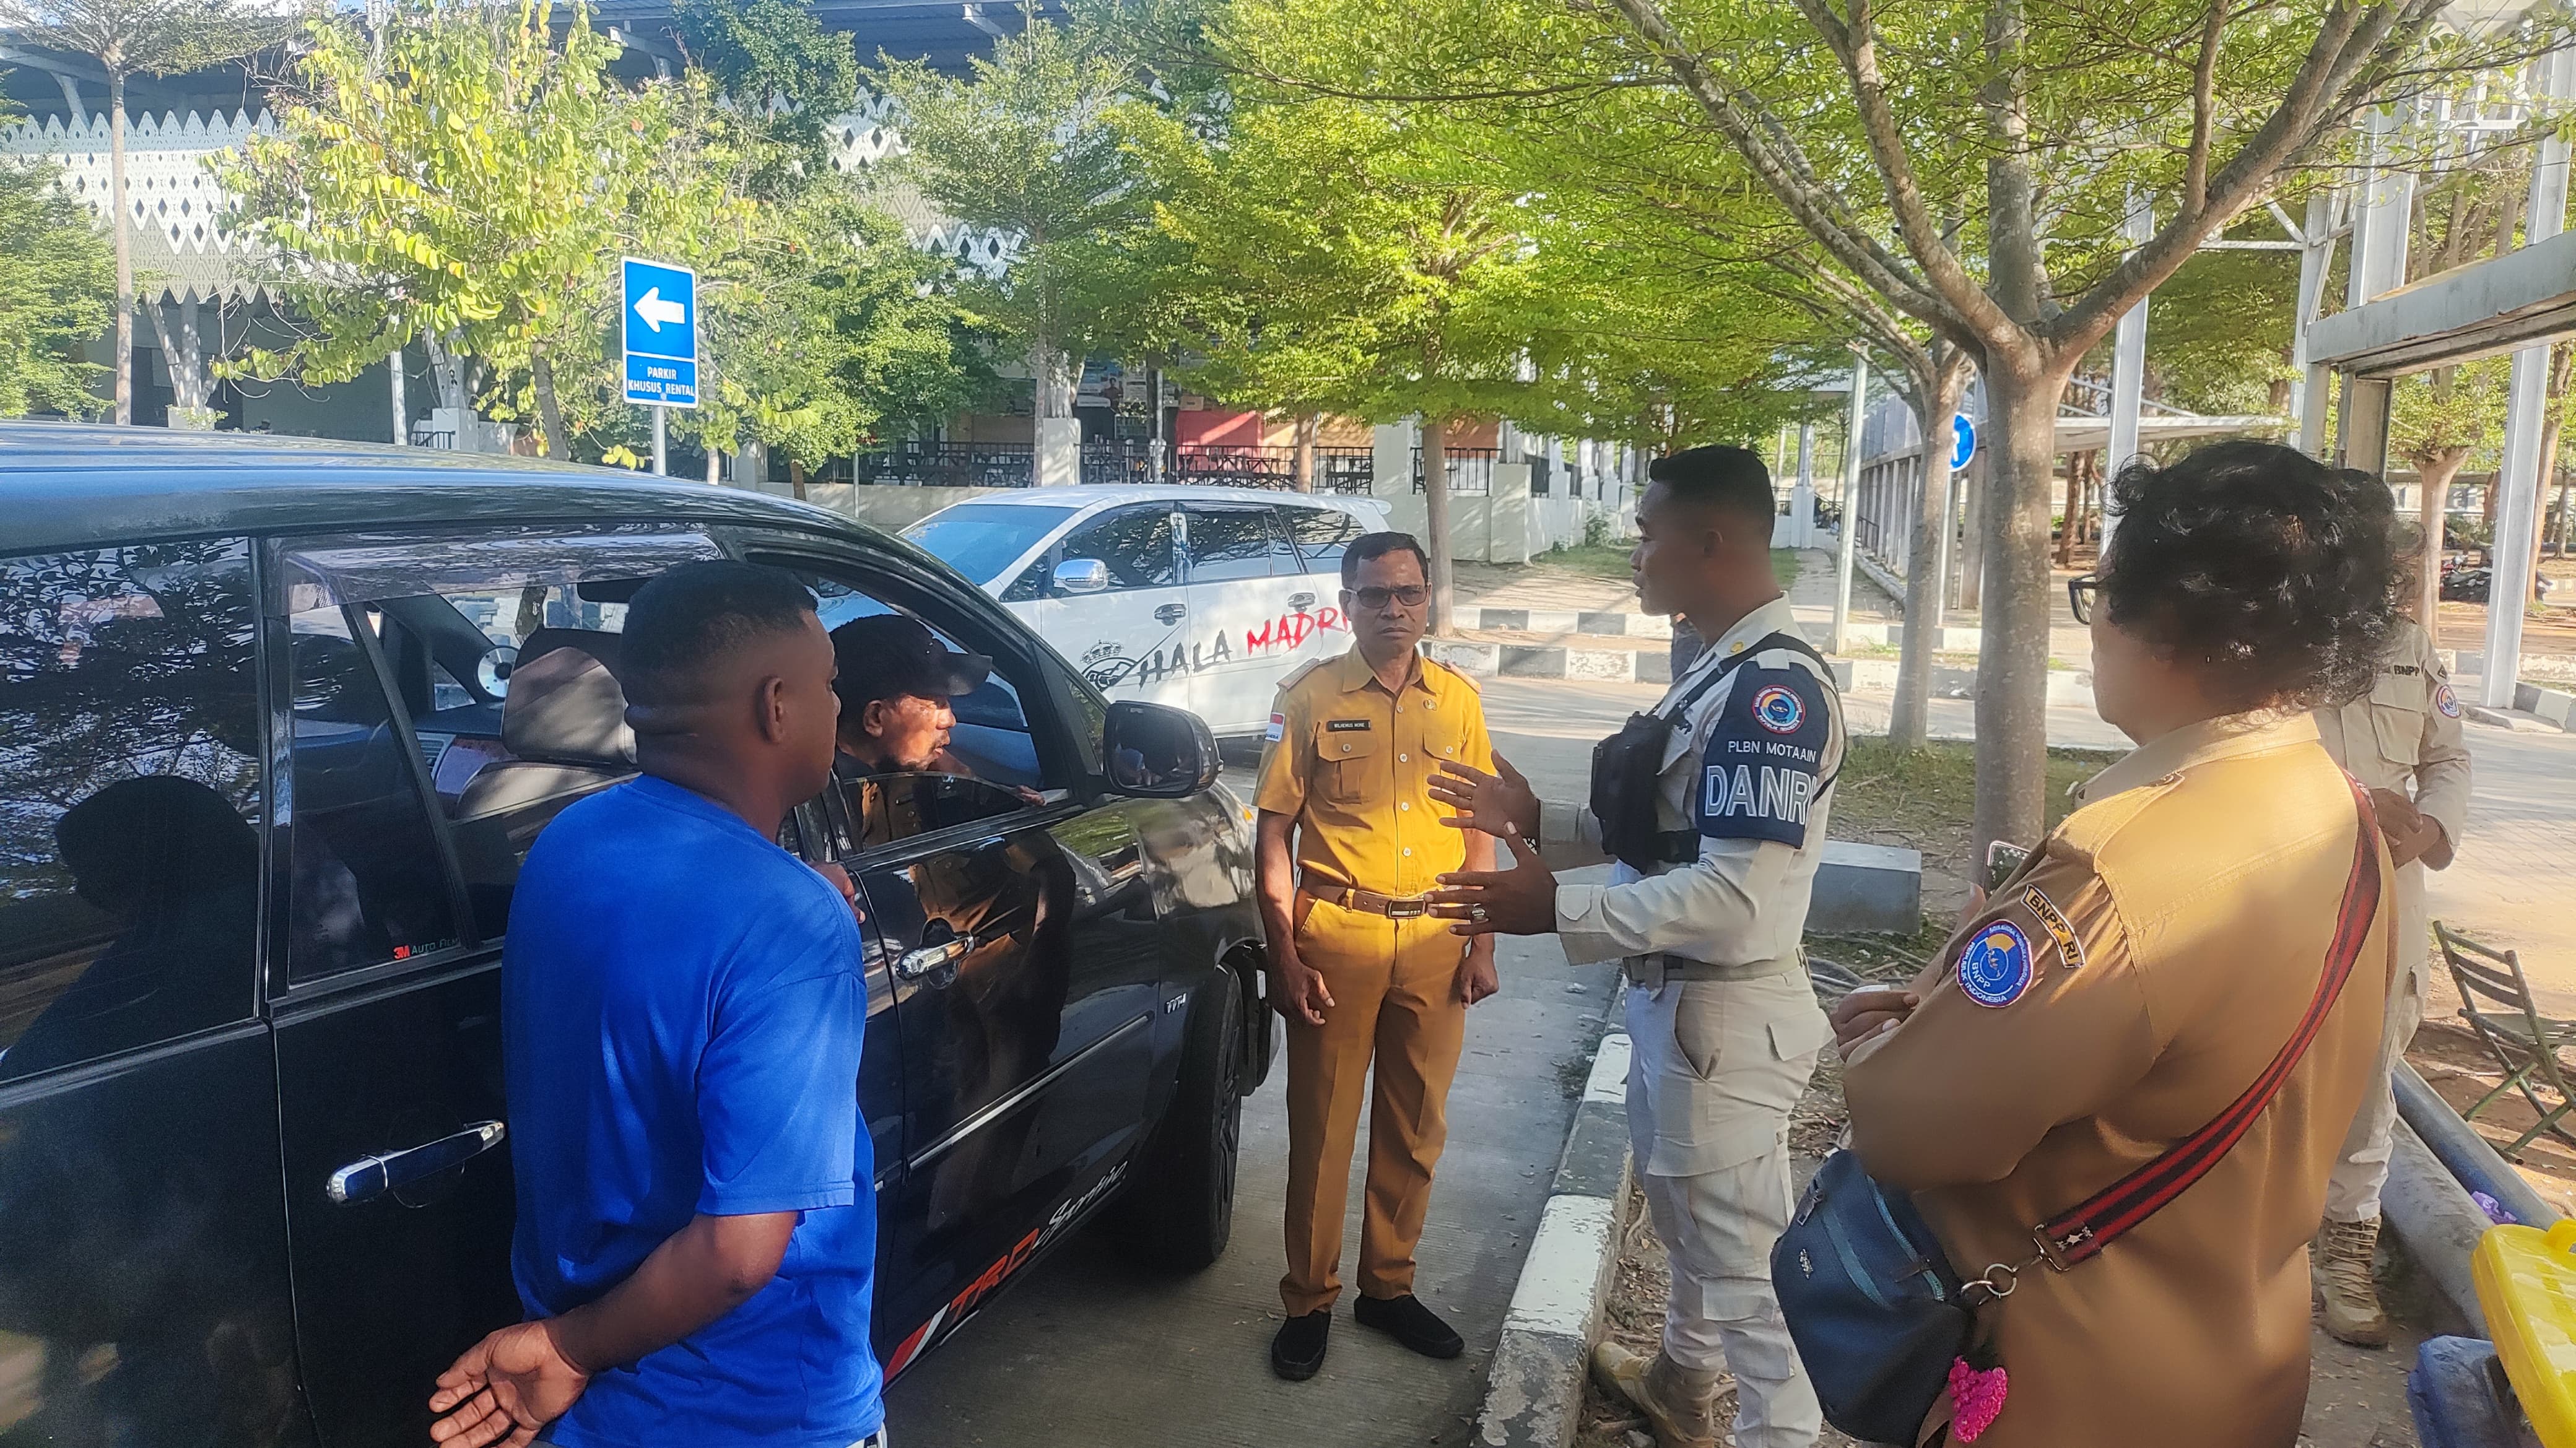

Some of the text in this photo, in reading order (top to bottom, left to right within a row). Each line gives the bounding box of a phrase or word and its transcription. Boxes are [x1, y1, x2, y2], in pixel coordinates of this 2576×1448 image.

[647, 366, 677, 380] PARKIR
[628, 379, 695, 396] KHUSUS RENTAL
[1137, 607, 1351, 691] HALA MADRI
[1728, 741, 1817, 763] PLBN MOTAAIN
[1705, 765, 1817, 825] DANR
[2029, 895, 2078, 960] BNPP RI
[393, 945, 411, 960] 3M
[1972, 962, 1991, 988] BNPP
[1965, 982, 2007, 1003] INDONESIA
[949, 1228, 1039, 1324] TRD
